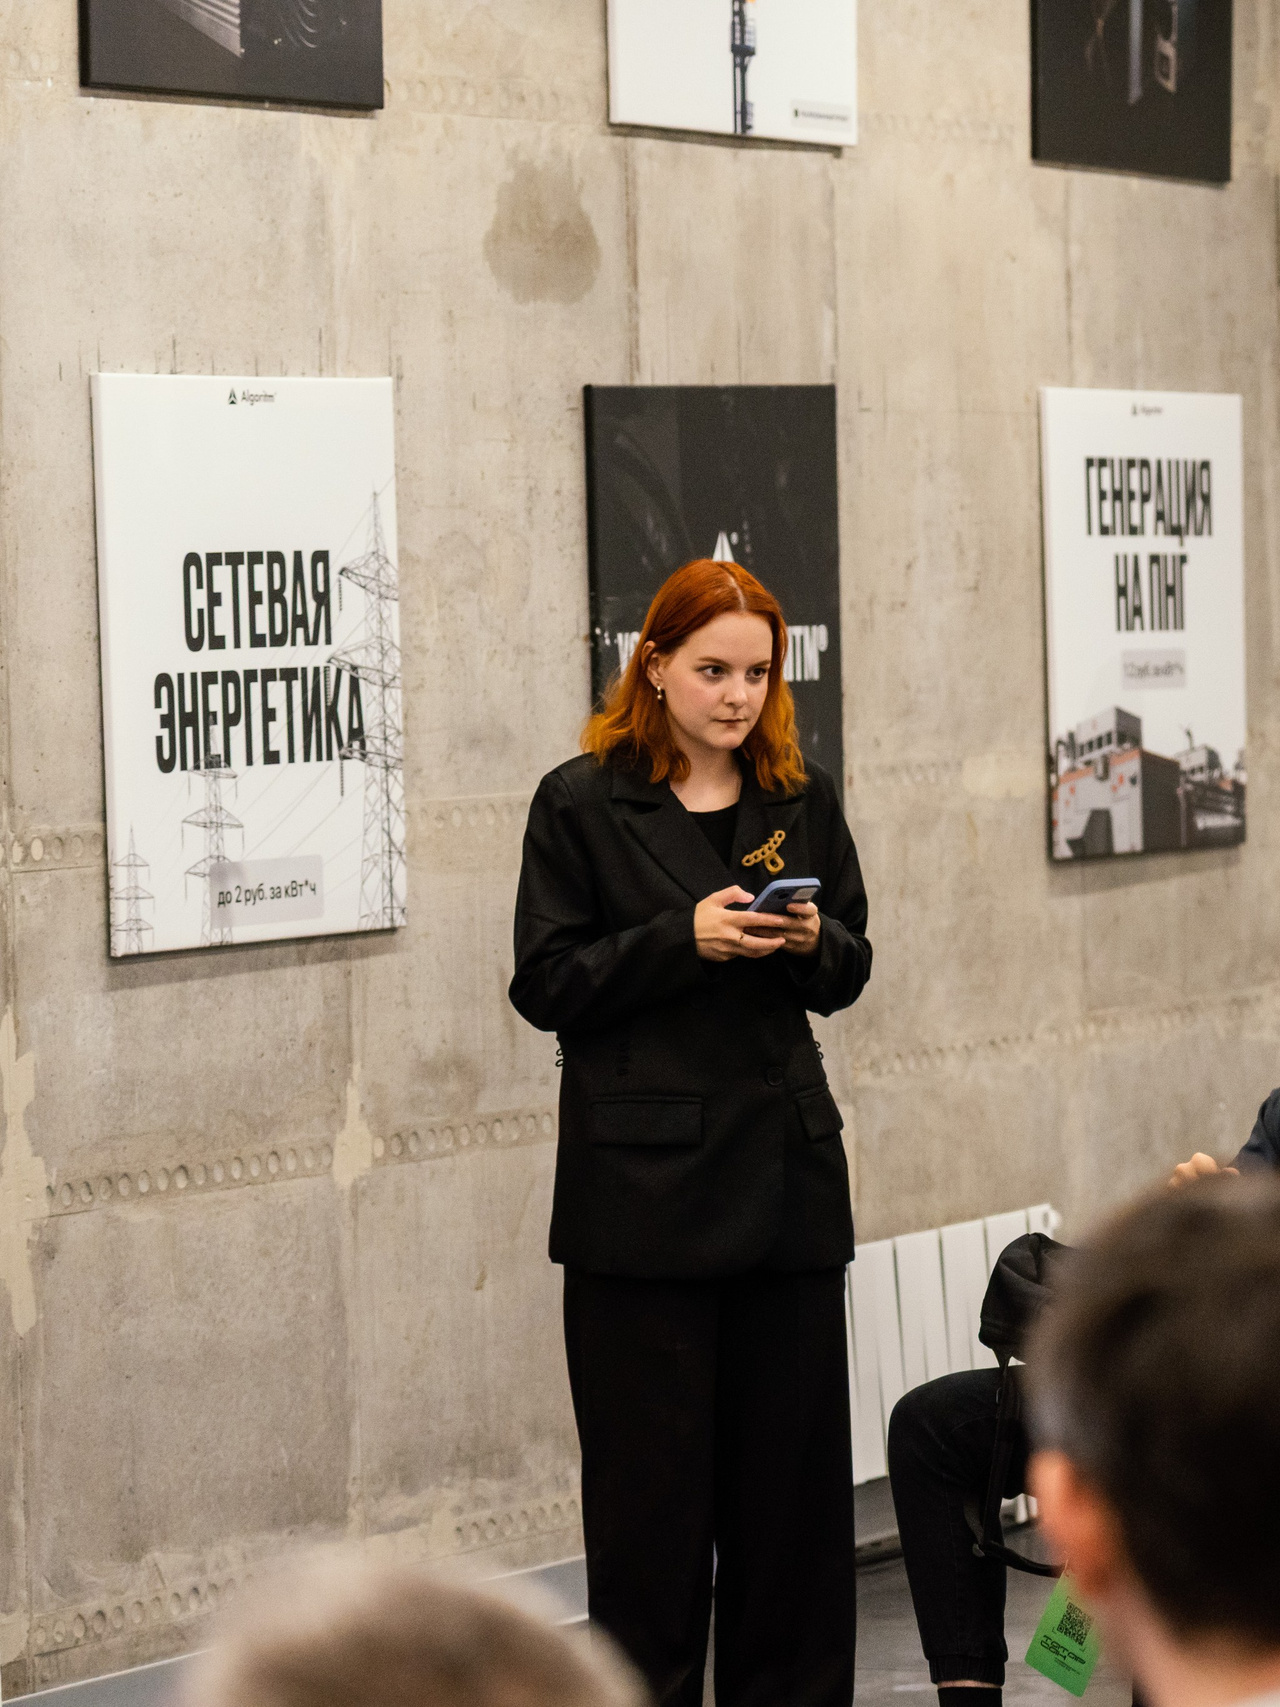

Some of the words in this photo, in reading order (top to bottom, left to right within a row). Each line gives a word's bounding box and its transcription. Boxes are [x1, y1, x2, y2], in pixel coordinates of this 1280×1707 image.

[1085, 457, 1213, 547] ГЕНЕРАЦИЯ
[183, 550, 332, 652] СЕТЕВАЯ
[1115, 554, 1144, 631] НА
[1149, 554, 1187, 631] ПНГ
[153, 665, 366, 774] ЭНЕРГЕТИКА
[217, 891, 232, 908] до
[235, 885, 242, 903] 2
[244, 883, 267, 905] руб.
[270, 886, 282, 900] за
